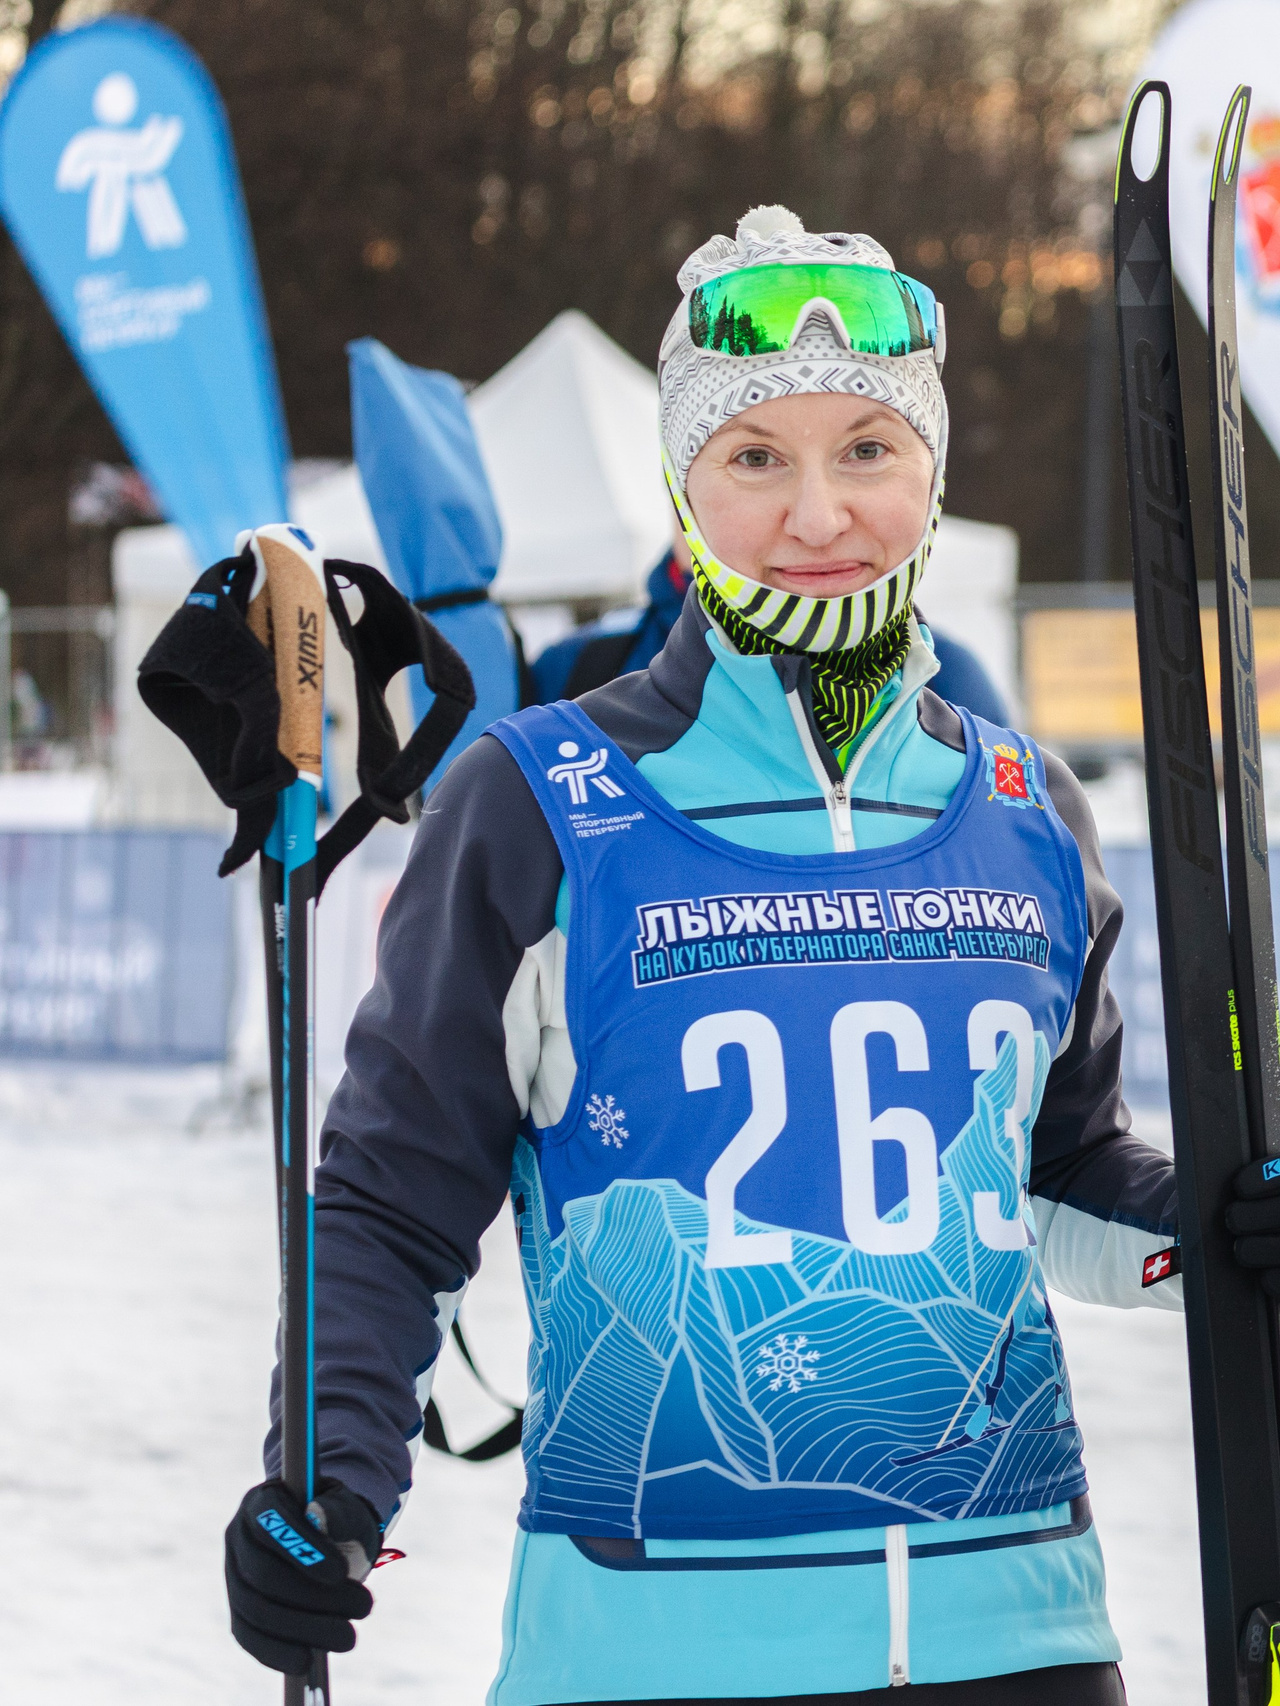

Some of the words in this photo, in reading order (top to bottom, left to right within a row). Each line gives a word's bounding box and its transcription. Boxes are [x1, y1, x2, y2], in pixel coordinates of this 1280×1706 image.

[1219, 340, 1267, 873] FISCHER
[568, 813, 587, 821] МЫ
[572, 811, 645, 829] СПОРТИВНЫЙ
[576, 823, 632, 838] ПЕТЕРБУРГ
[643, 894, 882, 949] ЛЫЖНЫЕ
[893, 892, 1043, 933] ГОНКИ
[638, 951, 667, 981] НА
[671, 939, 741, 974] КУБОК
[745, 932, 886, 963] ГУБЕРНАТОРА
[888, 931, 1048, 966] САНКТ-ПЕТЕРБУРГА
[680, 999, 1037, 1270] 263
